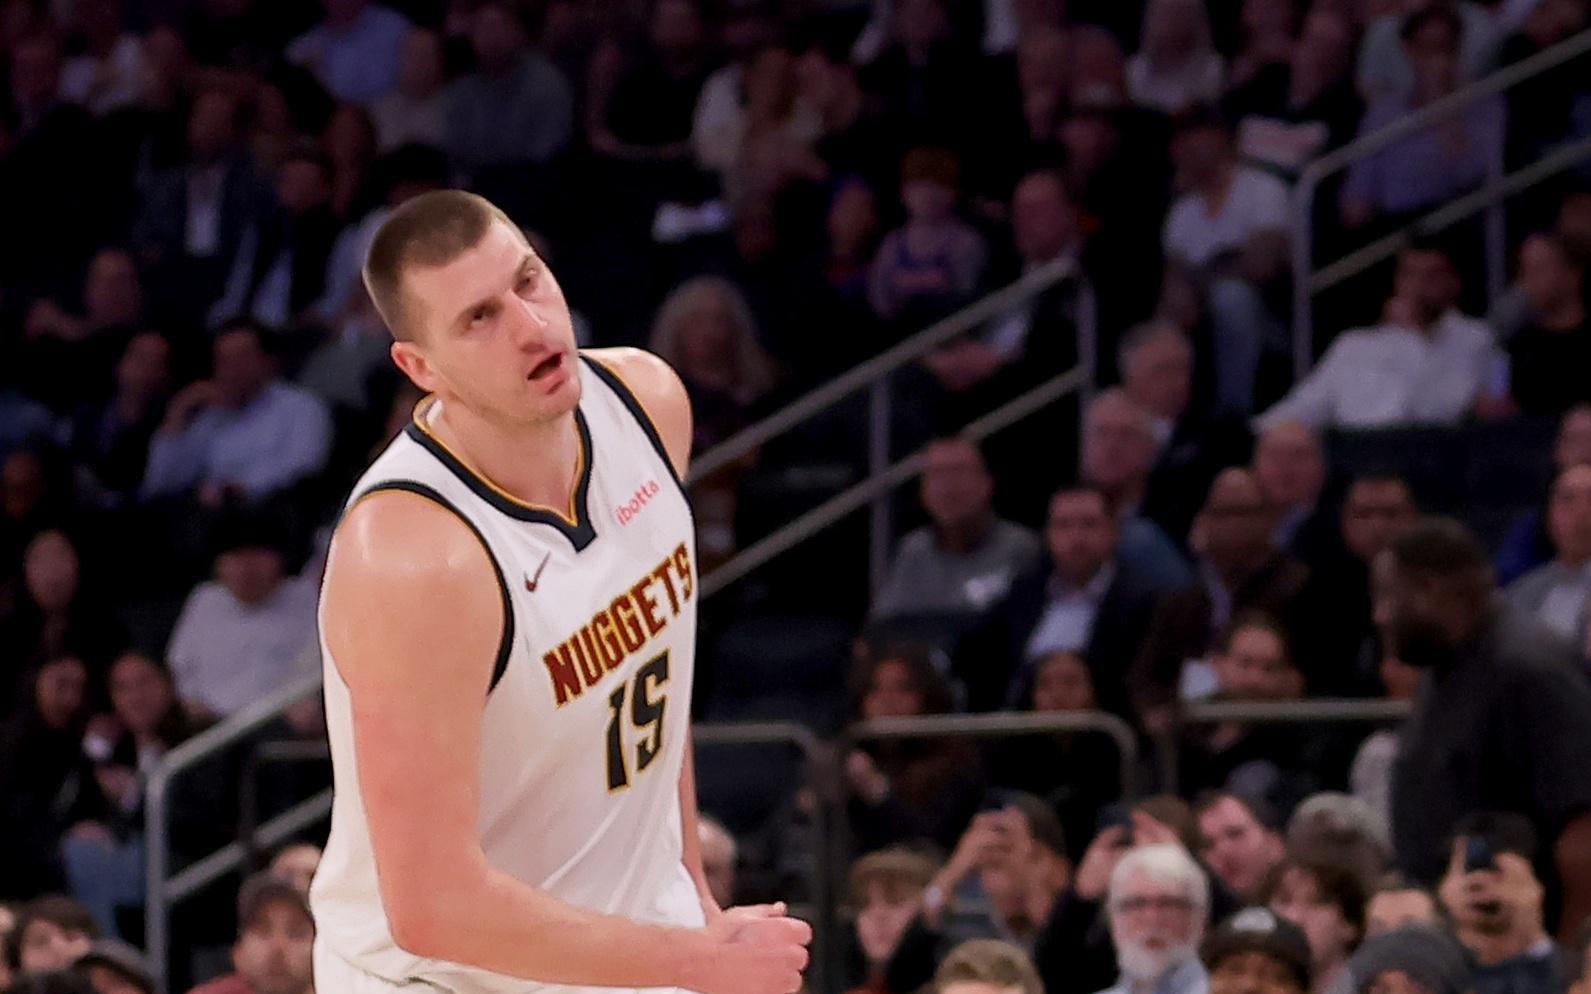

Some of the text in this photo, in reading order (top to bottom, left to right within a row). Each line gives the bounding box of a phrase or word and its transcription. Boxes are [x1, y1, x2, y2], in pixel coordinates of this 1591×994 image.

[616, 479, 661, 528] ibotta
[543, 542, 693, 706] NUGGETS
[605, 649, 671, 793] 15
